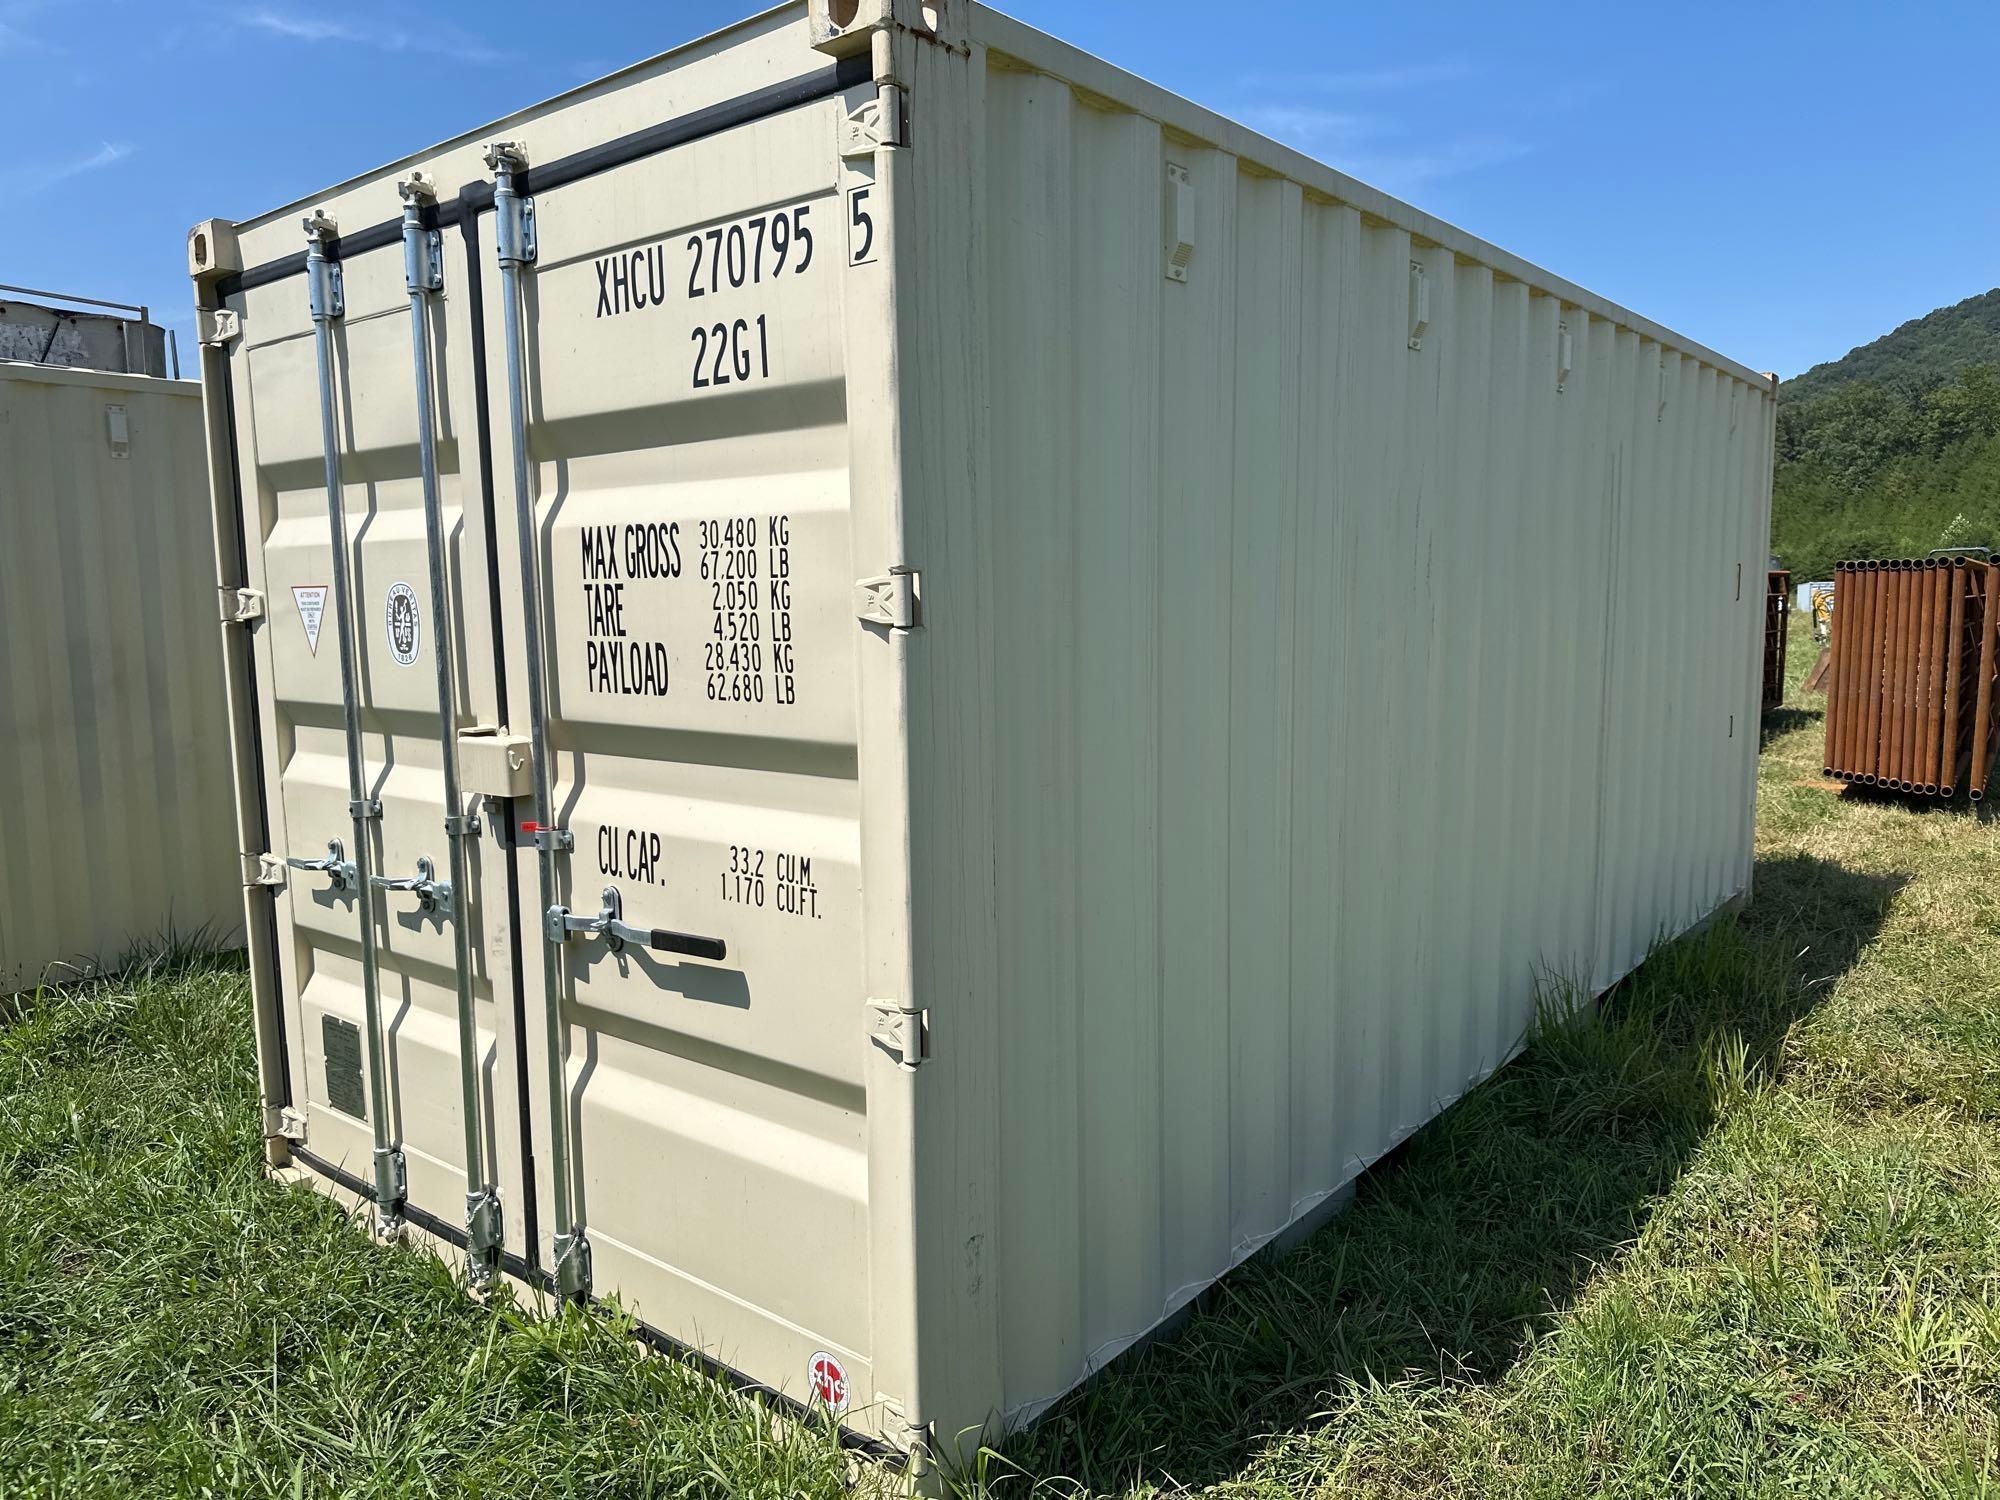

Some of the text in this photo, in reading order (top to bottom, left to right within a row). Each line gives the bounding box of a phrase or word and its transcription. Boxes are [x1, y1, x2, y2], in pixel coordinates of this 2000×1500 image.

[595, 188, 873, 319] XHCU 270795 5
[691, 313, 769, 389] 22G1
[581, 515, 789, 580] MAX GROSS 30,480 KG
[700, 547, 789, 580] 67,200 LB
[583, 579, 791, 637] TARE 2,050 KG
[713, 611, 792, 642] 4,520 LB
[586, 640, 794, 697] PAYLOAD 28,430 KG
[707, 672, 796, 705] 62,680 LB
[729, 845, 764, 879] 33.2
[721, 872, 764, 908] 1,170
